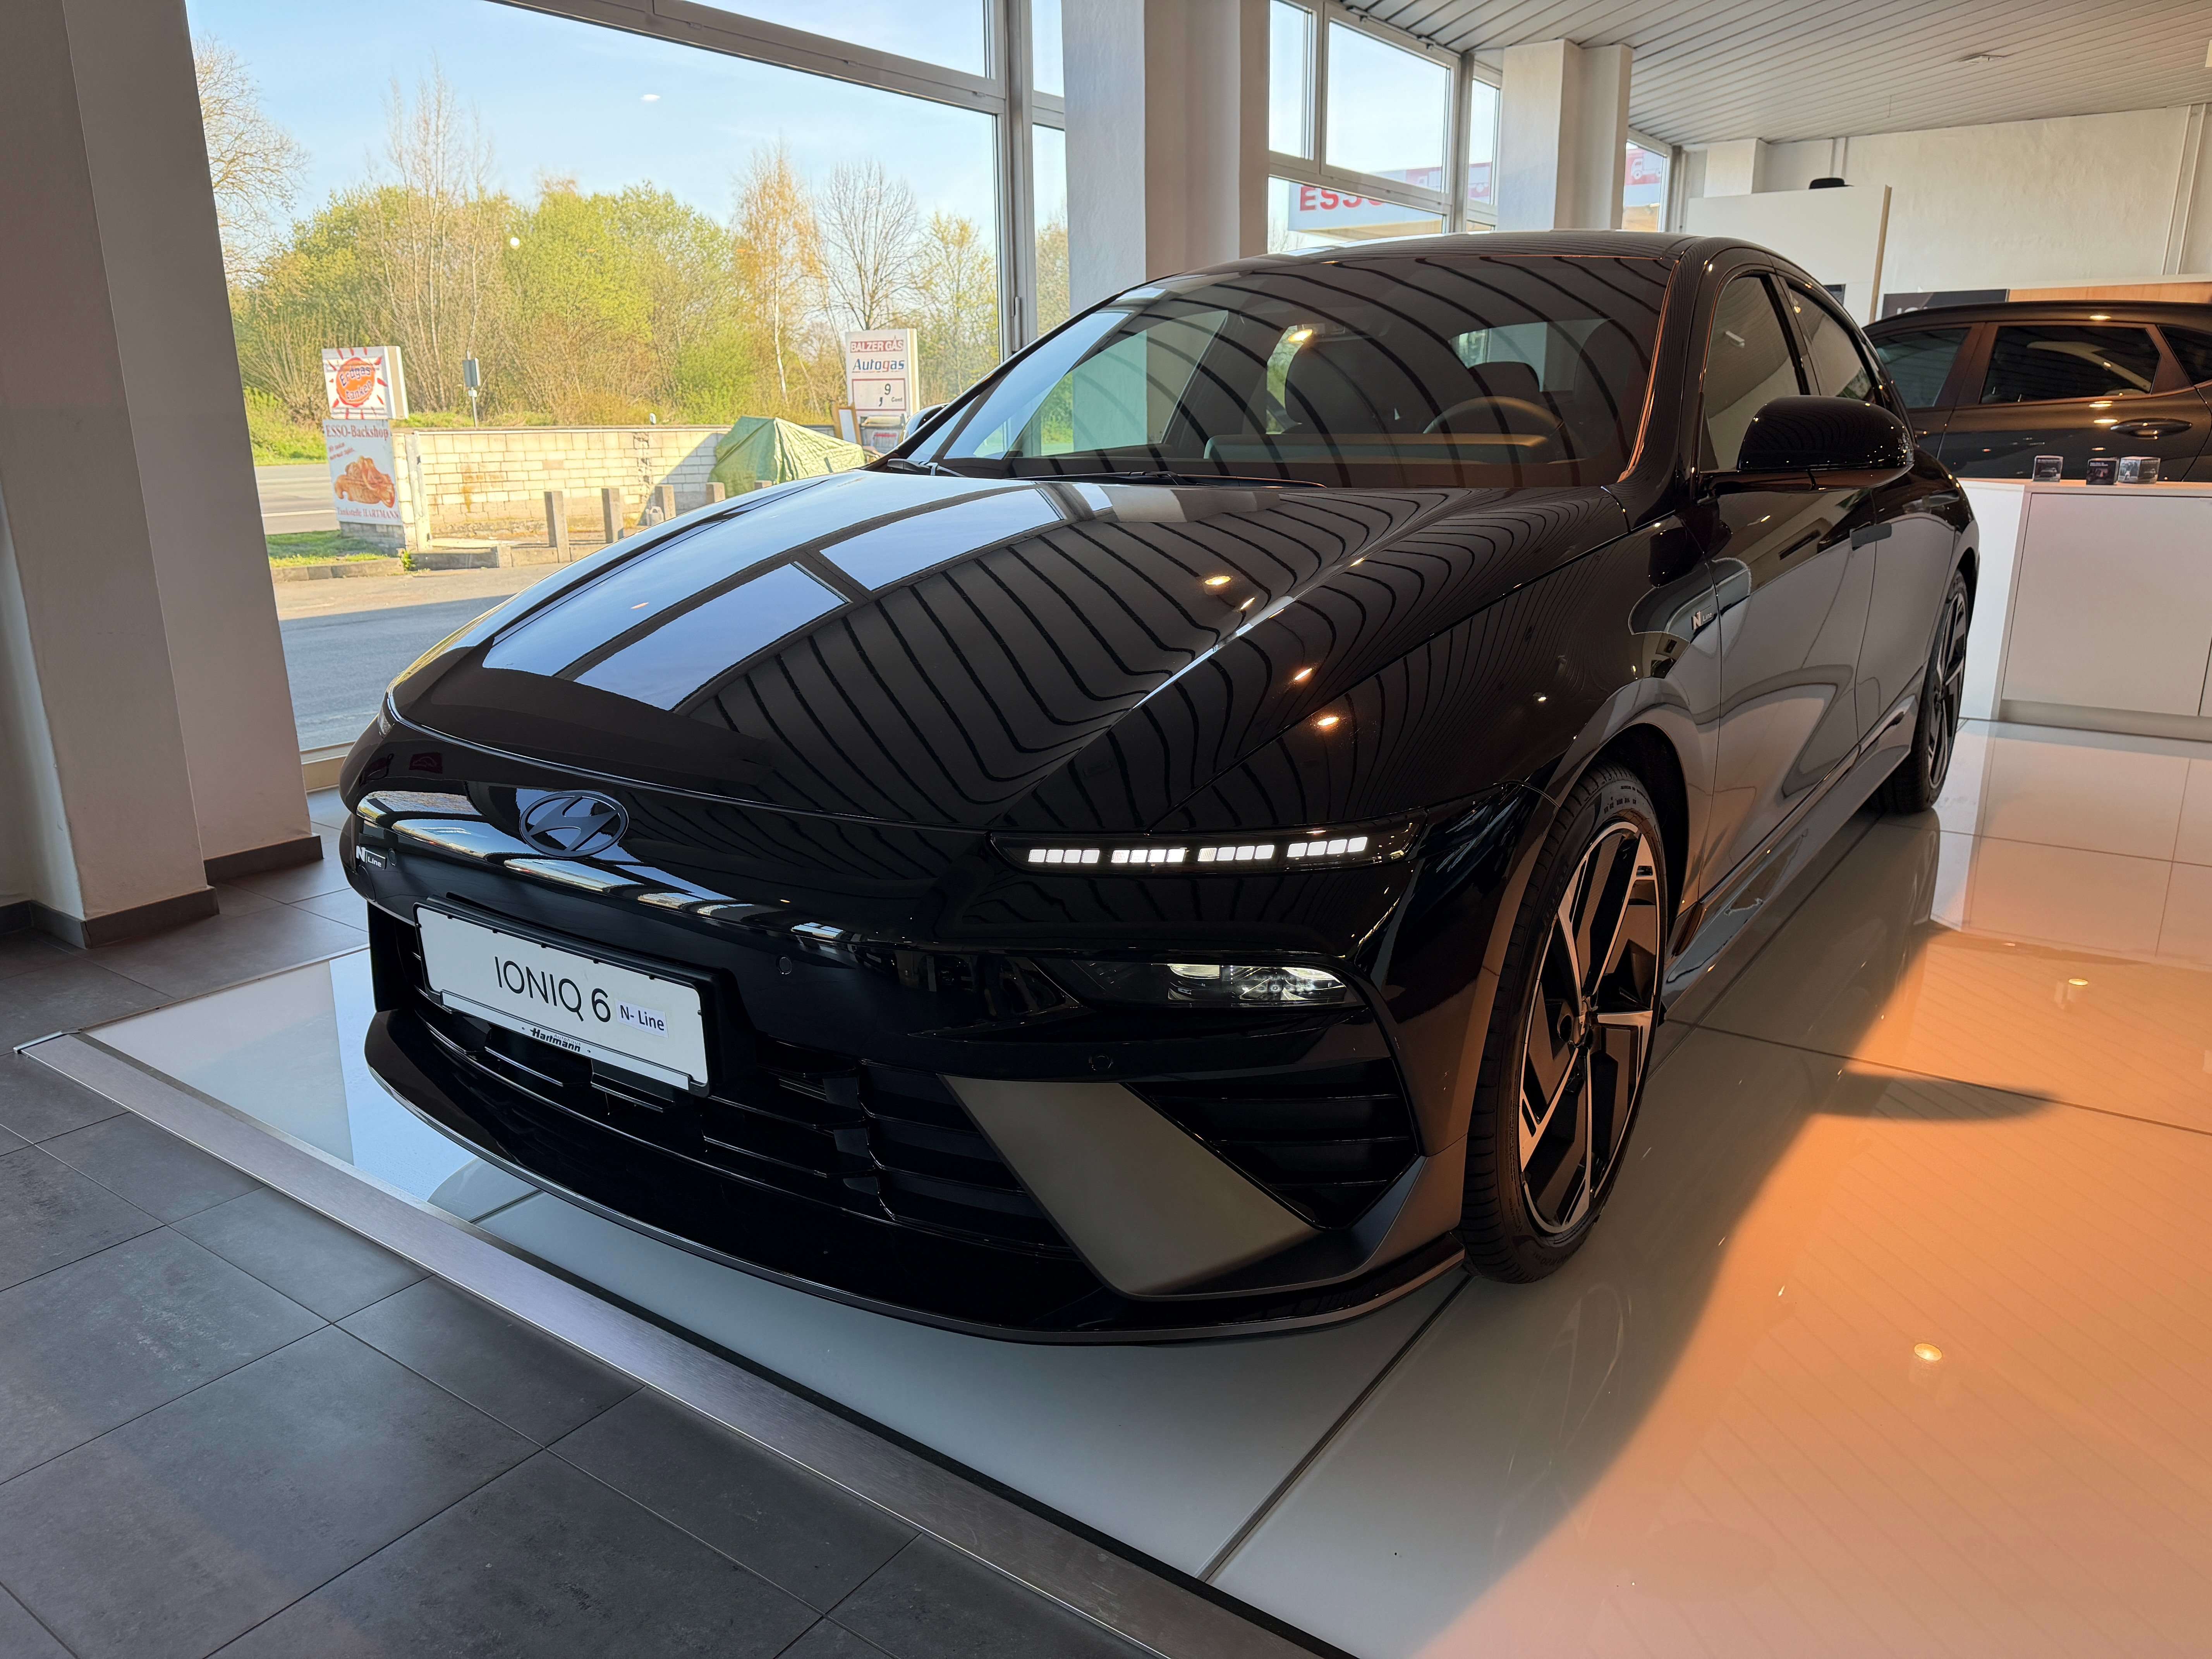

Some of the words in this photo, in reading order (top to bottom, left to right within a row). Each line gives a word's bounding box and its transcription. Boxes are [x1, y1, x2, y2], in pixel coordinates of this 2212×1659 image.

[1300, 185, 1382, 211] ES
[851, 341, 884, 352] BALZER
[853, 358, 905, 372] Autogas
[340, 366, 371, 386] Erdgas
[346, 381, 372, 399] tanken
[326, 425, 389, 441] ESSO-Backshop
[356, 845, 366, 862] N
[368, 856, 382, 867] Line
[495, 956, 584, 1022] IONIQ
[591, 988, 611, 1022] 6
[638, 1010, 665, 1031] Line
[530, 1028, 581, 1052] Hartmann
[554, 1034, 581, 1046] Autohaus
